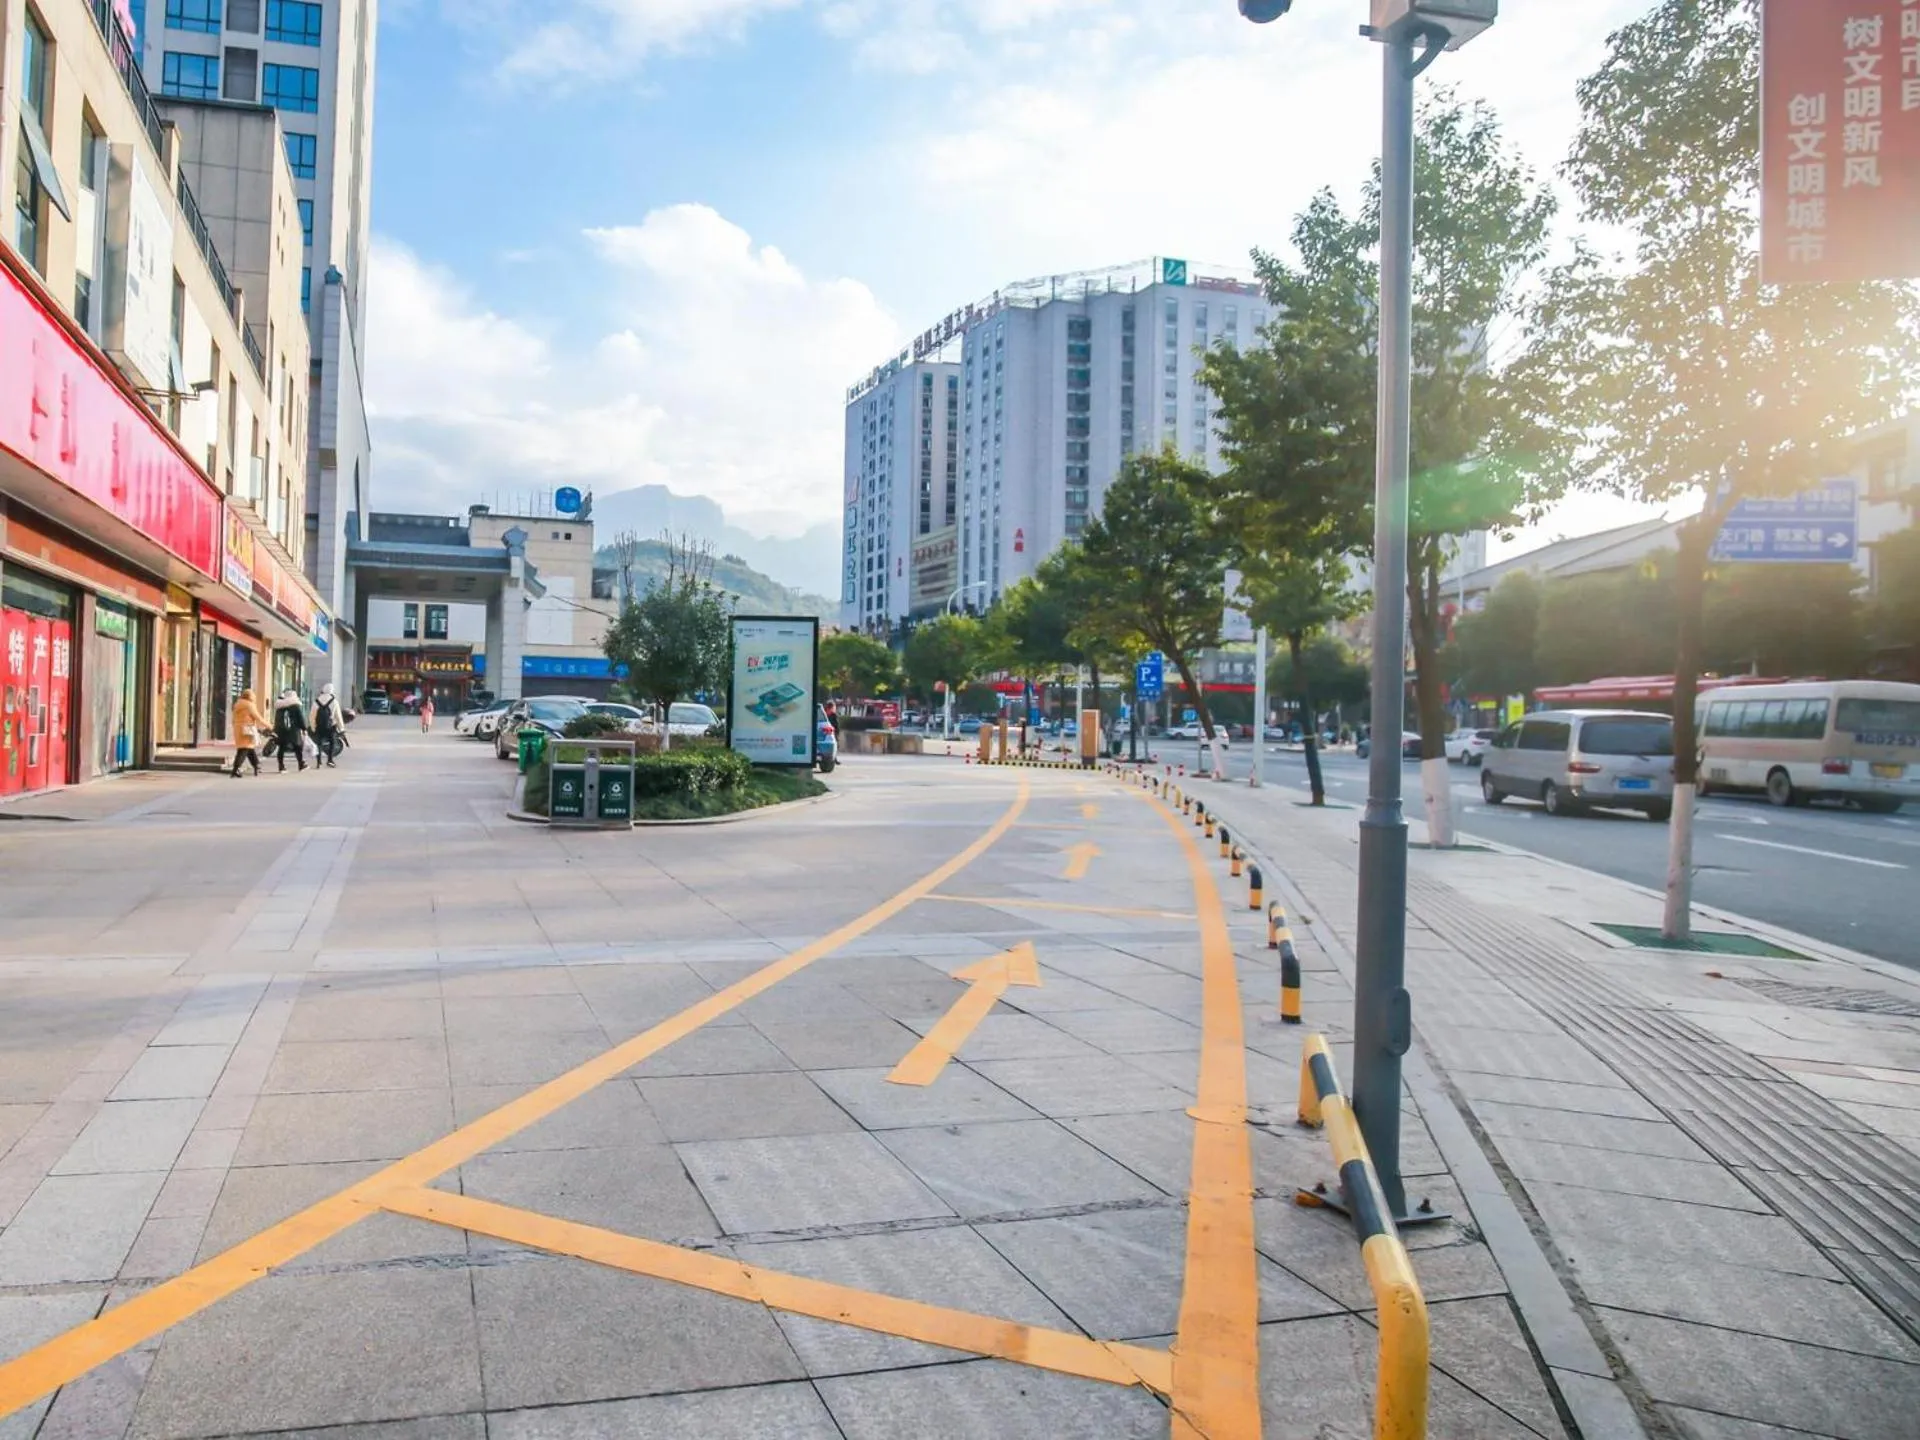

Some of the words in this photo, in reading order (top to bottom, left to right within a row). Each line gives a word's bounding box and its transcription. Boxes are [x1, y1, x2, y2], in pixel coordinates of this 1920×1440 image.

[1787, 92, 1827, 263] 创文明城市
[1843, 14, 1883, 188] 树文明新风
[1140, 667, 1151, 681] P
